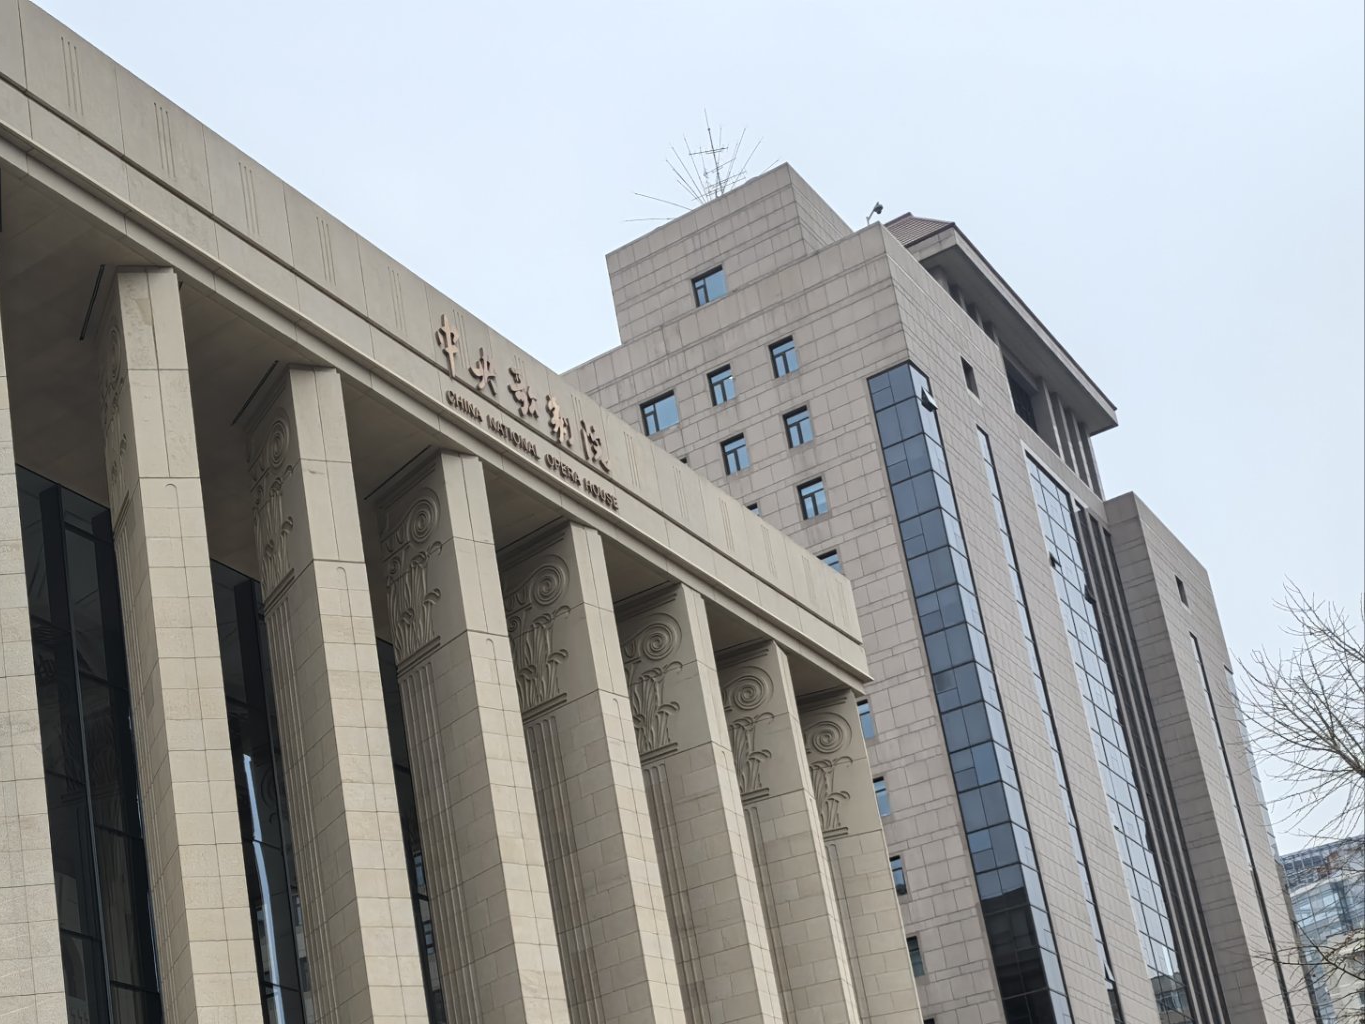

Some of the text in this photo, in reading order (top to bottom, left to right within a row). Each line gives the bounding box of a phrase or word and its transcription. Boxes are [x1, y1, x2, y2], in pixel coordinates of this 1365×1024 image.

[446, 391, 619, 511] CHINA NATIONAL OPERA HOUSE
